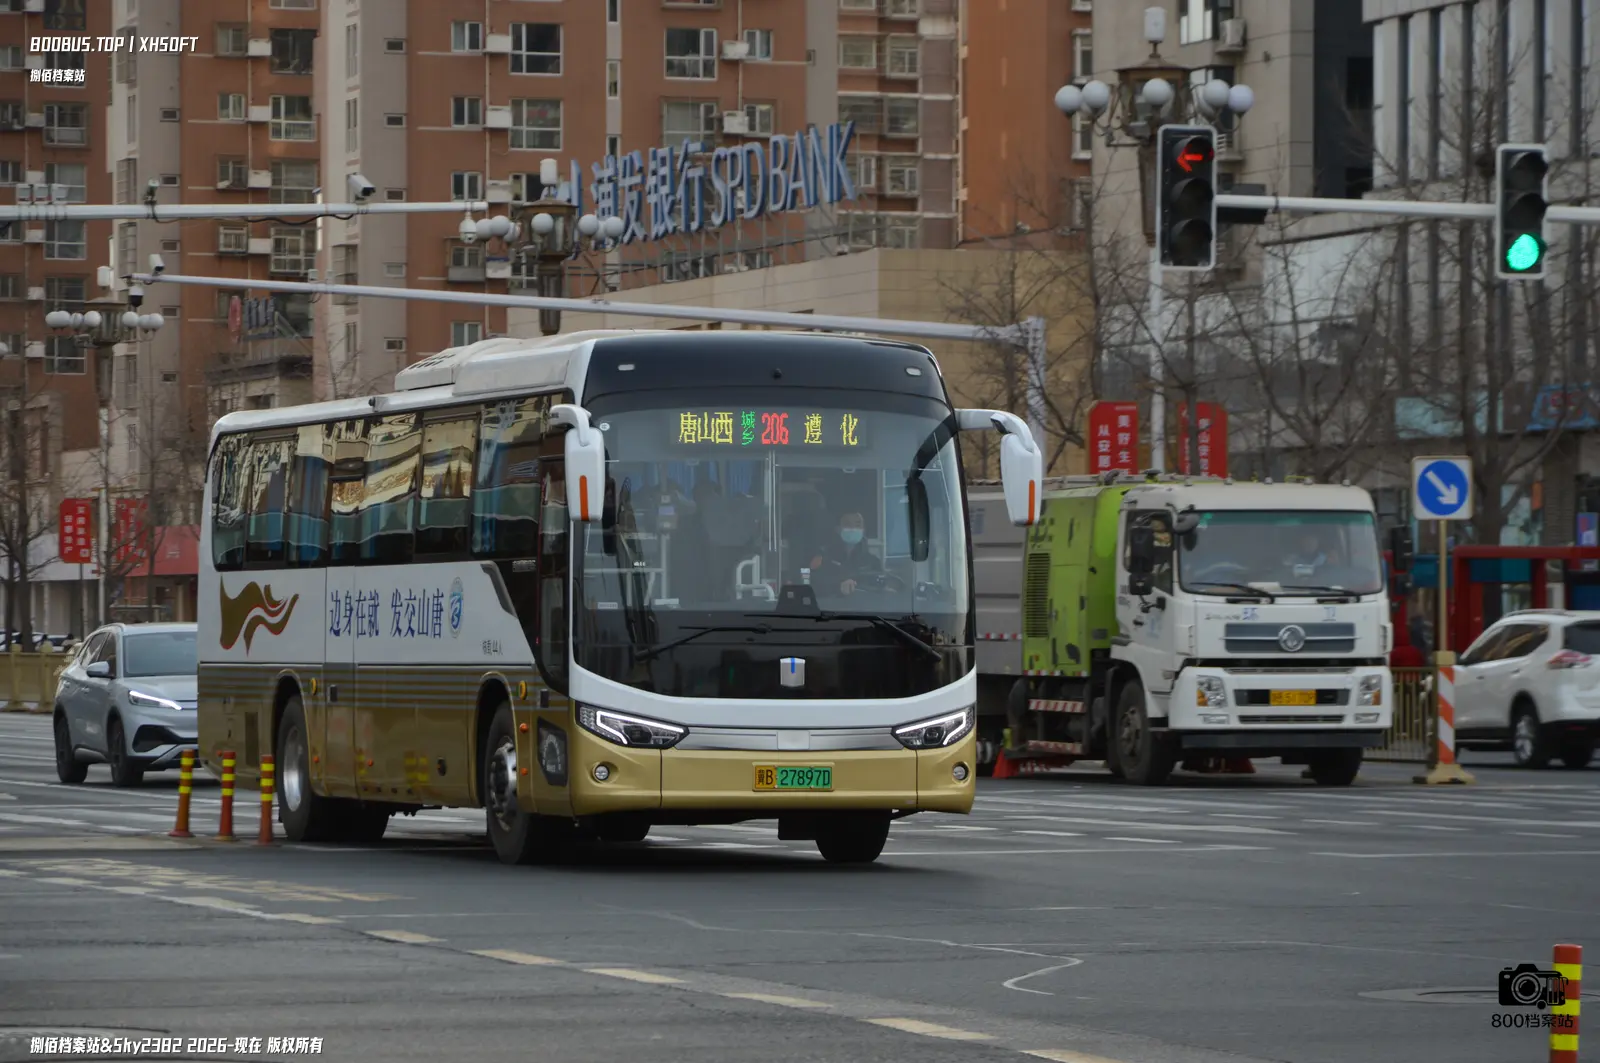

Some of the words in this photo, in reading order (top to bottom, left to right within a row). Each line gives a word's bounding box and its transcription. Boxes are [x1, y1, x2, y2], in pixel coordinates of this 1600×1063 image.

[769, 120, 857, 212] BANK
[679, 411, 734, 444] 唐山西
[761, 412, 789, 445] 206
[779, 769, 831, 787] 27897D
